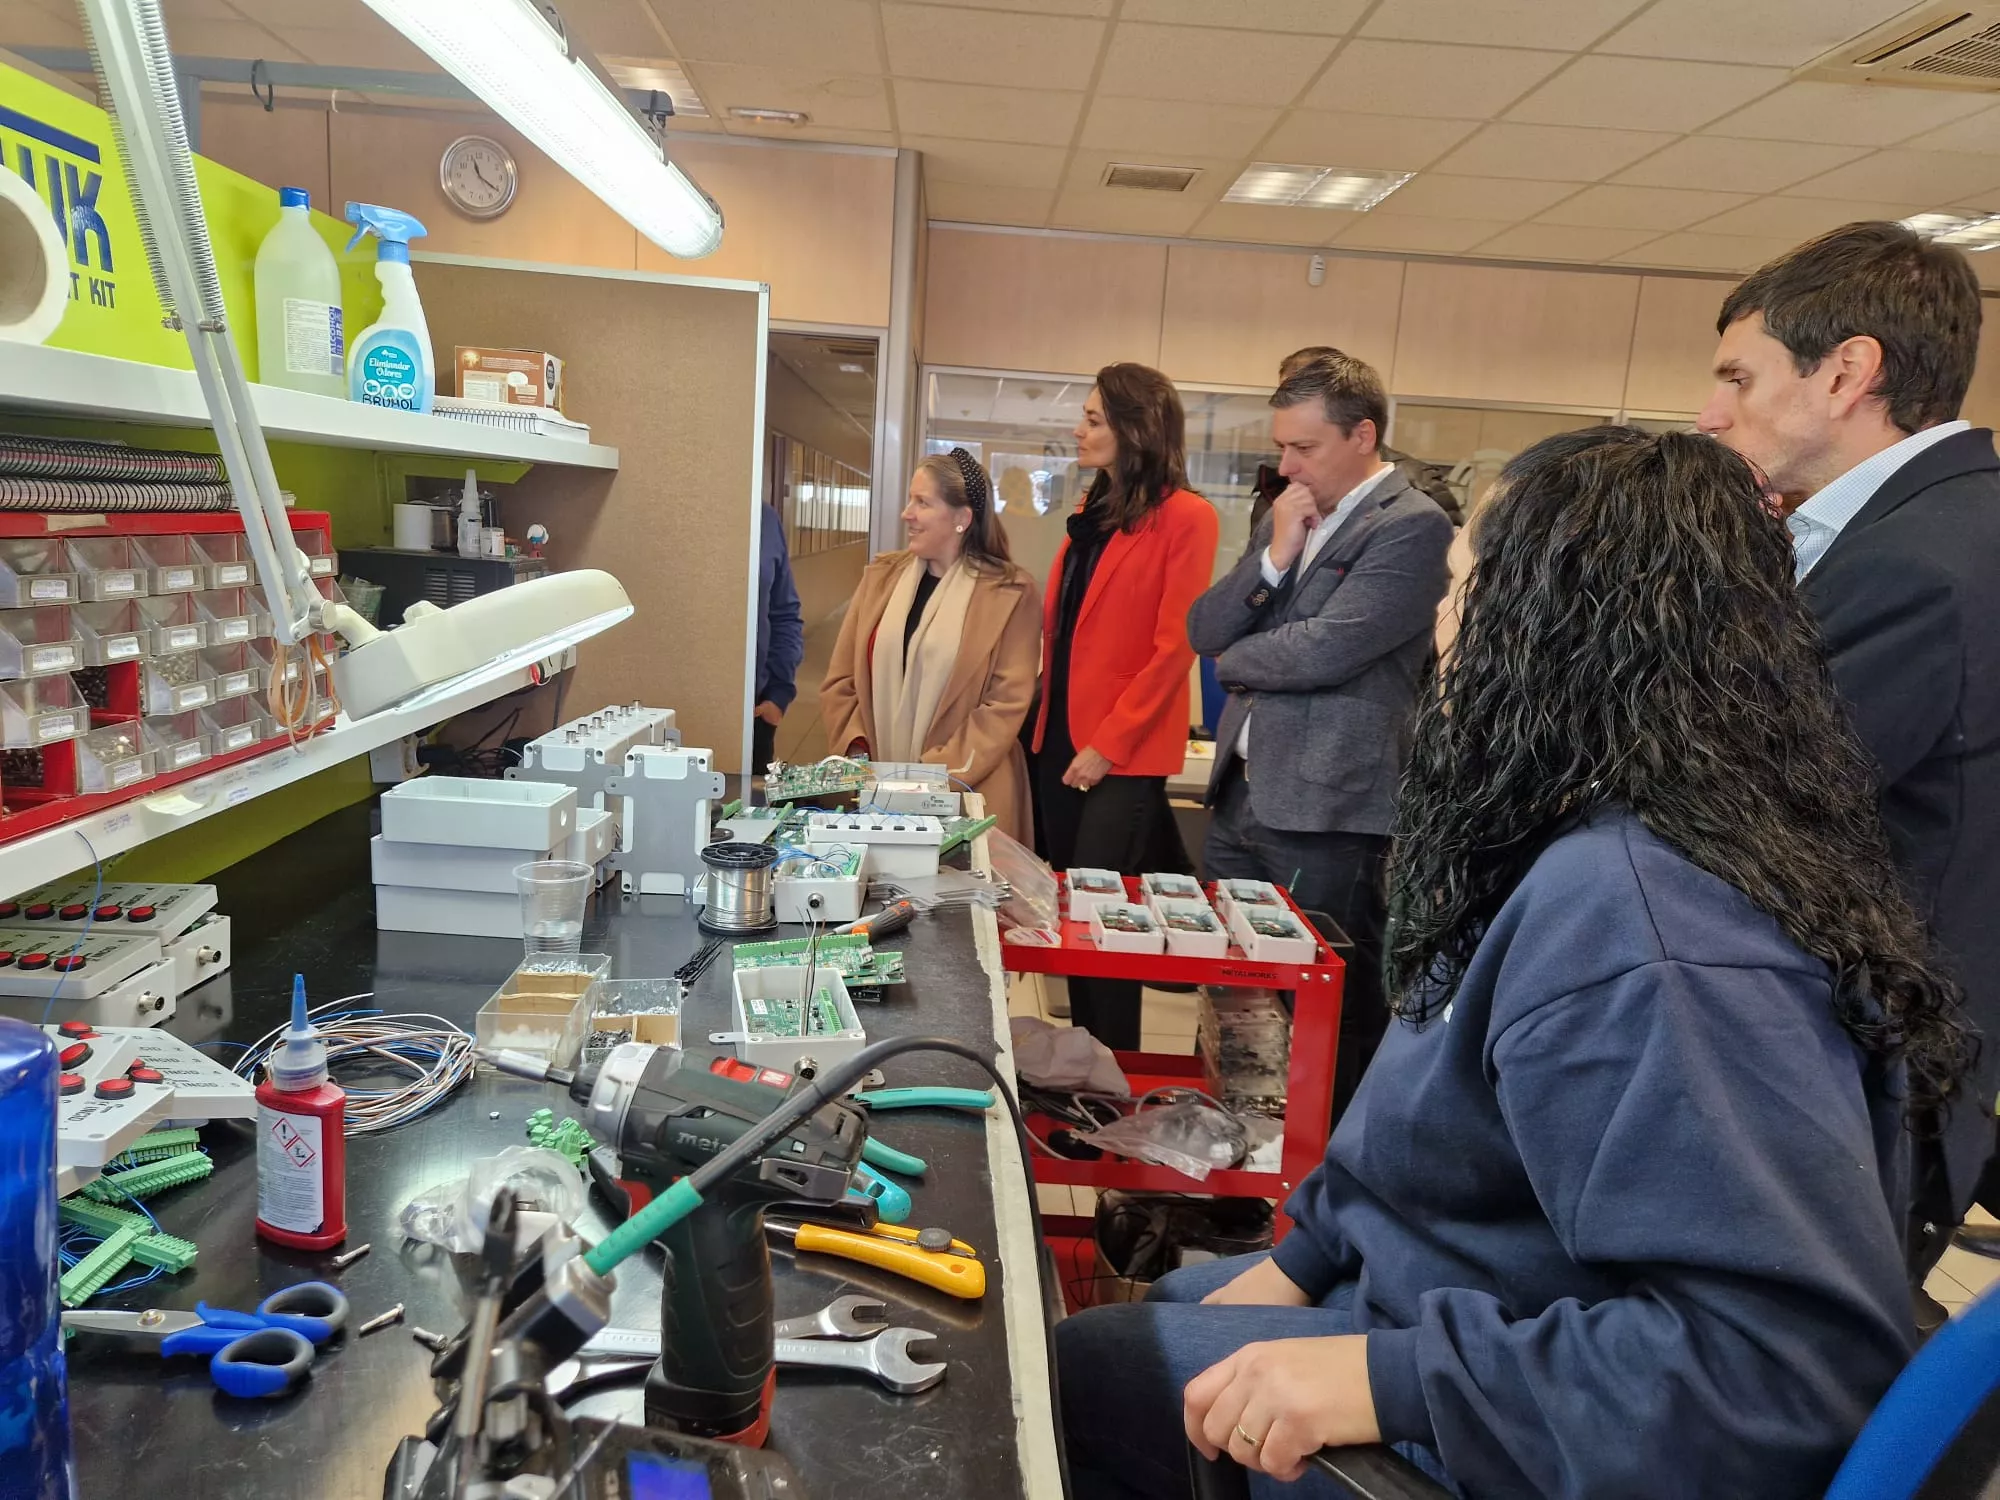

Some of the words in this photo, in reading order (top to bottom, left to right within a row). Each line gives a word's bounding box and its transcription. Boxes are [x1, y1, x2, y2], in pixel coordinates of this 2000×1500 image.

[88, 276, 115, 309] KIT
[329, 305, 337, 355] ALCOHOL
[369, 357, 411, 371] Eliminador
[376, 367, 403, 379] Odores
